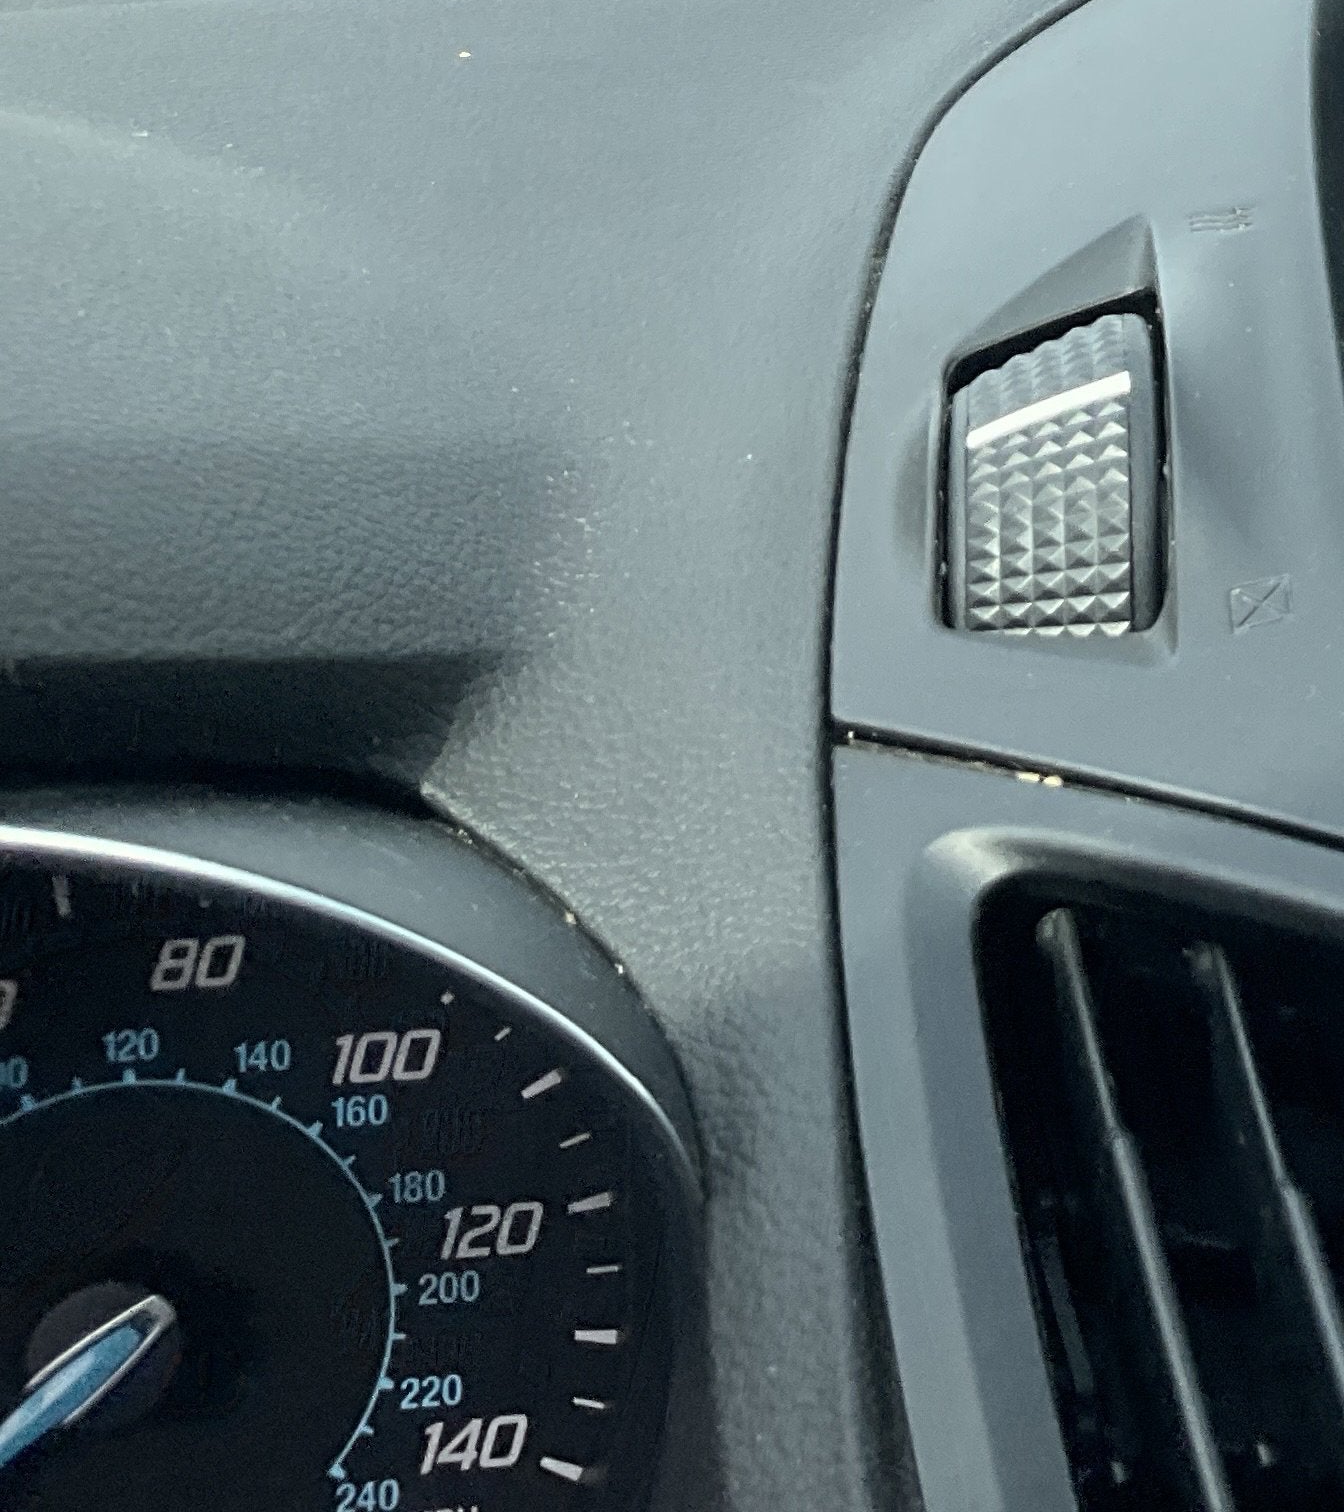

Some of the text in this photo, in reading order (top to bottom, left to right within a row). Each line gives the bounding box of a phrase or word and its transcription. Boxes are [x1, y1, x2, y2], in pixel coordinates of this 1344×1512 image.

[151, 935, 244, 990] 80
[102, 1027, 160, 1062] 120
[234, 1039, 291, 1072] 140
[331, 1029, 440, 1085] 100
[331, 1094, 389, 1128] 160
[389, 1170, 446, 1203] 180
[438, 1201, 543, 1260] 120
[418, 1270, 480, 1306] 200
[400, 1374, 463, 1408] 220
[420, 1414, 528, 1475] 140
[335, 1479, 401, 1512] 240
